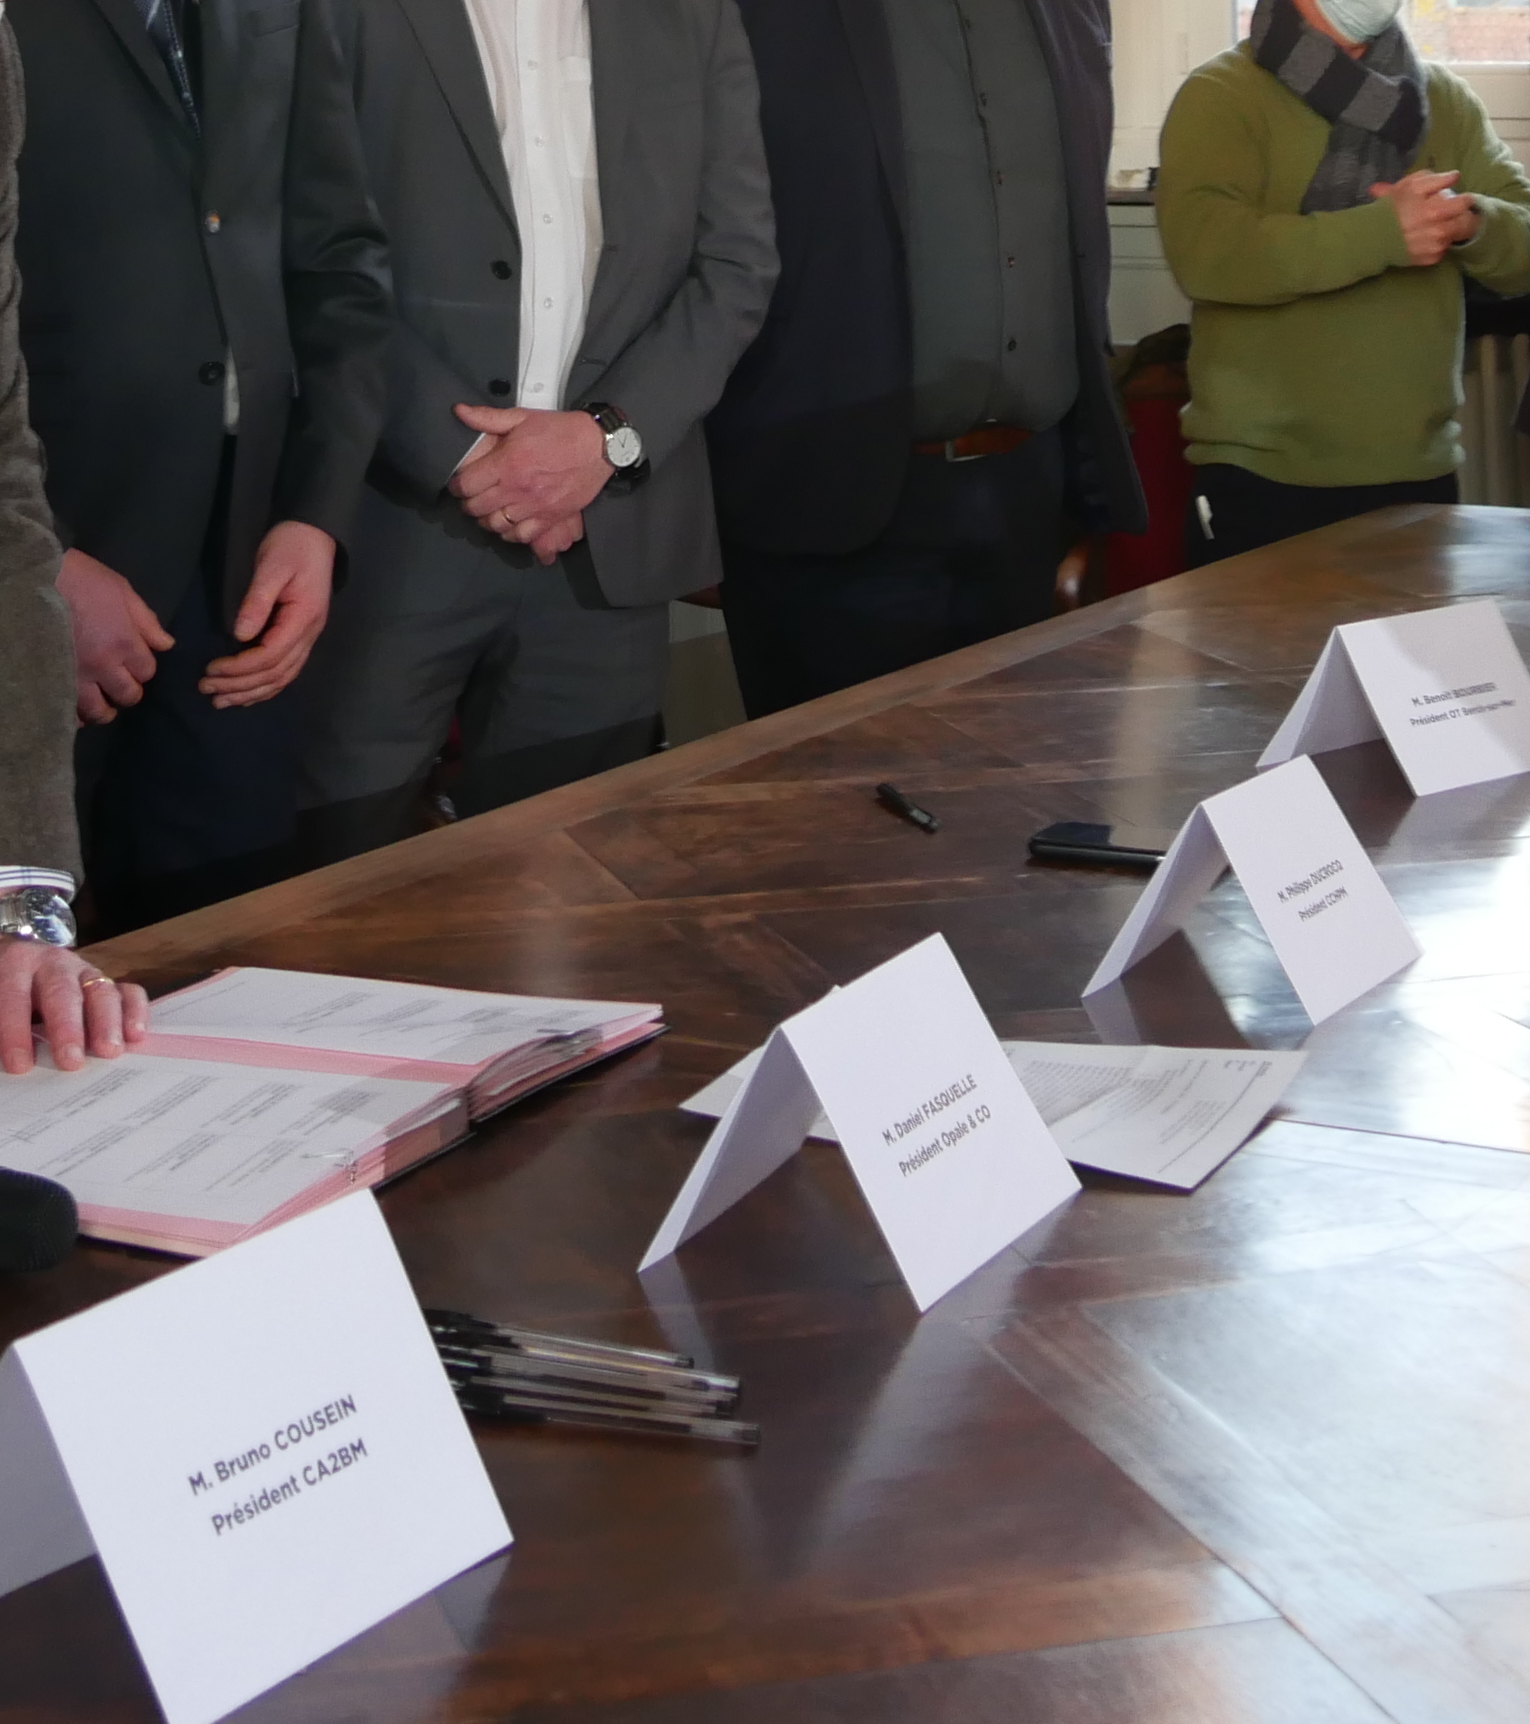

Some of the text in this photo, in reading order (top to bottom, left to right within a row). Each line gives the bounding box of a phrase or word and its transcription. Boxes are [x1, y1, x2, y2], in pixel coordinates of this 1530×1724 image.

[882, 1074, 977, 1145] M. Daniel FASQUELLE
[898, 1104, 991, 1177] Président Opale & CO
[188, 1394, 357, 1495] M. Bruno COUSEIN
[211, 1438, 368, 1536] Président CA2BM
